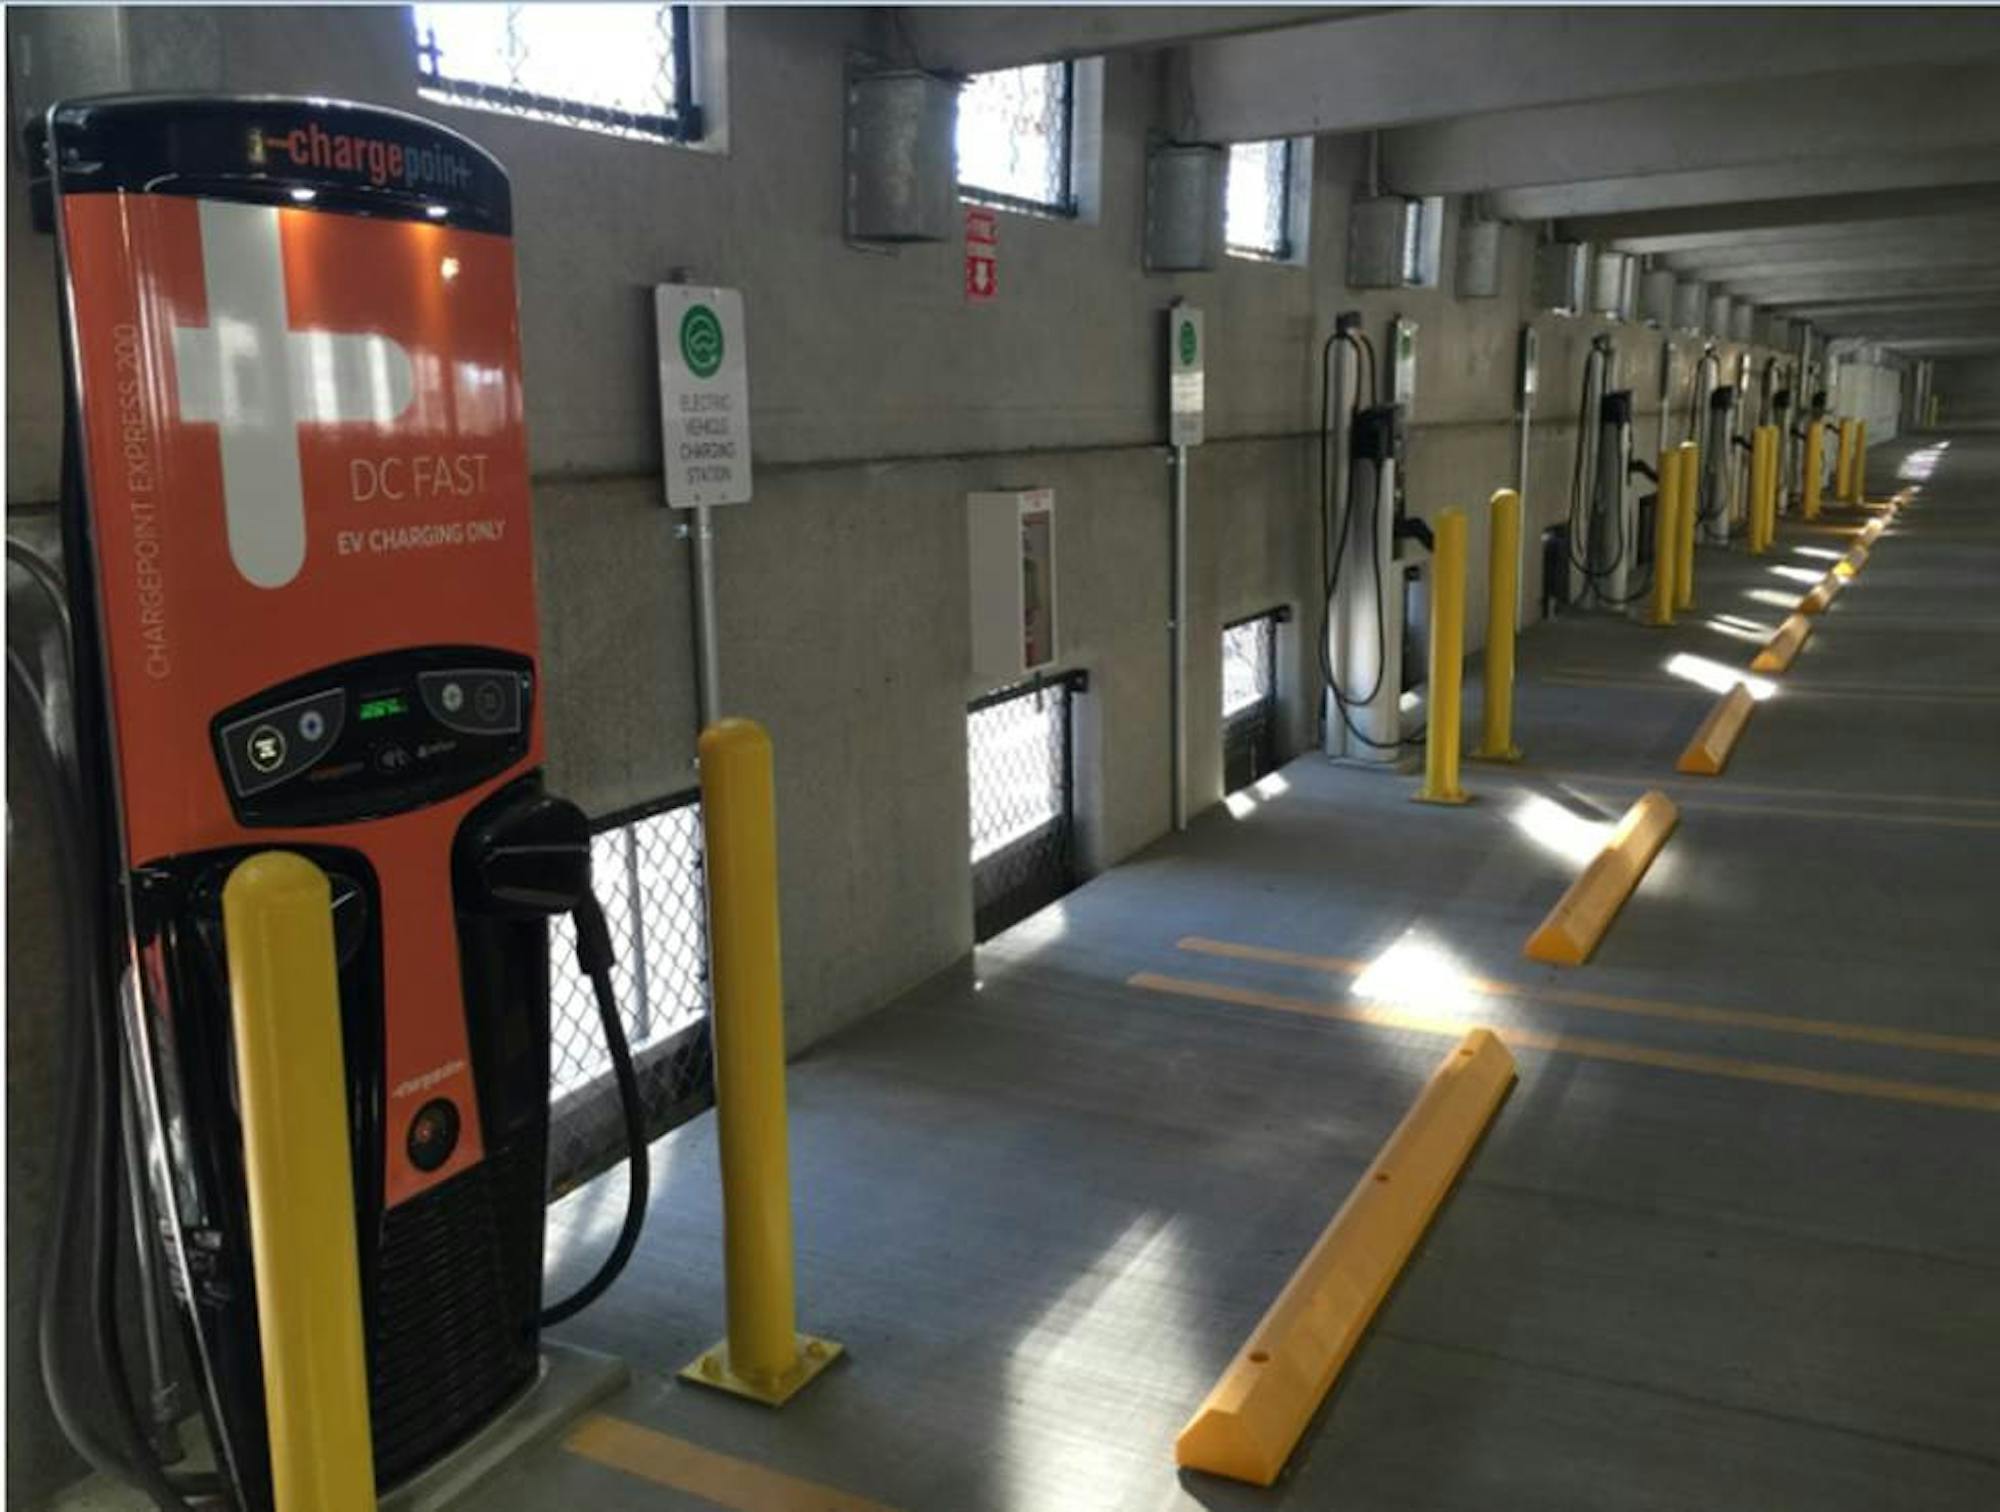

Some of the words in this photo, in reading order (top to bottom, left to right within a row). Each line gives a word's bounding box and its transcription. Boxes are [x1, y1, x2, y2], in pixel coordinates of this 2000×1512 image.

[117, 380, 154, 493] EXPRESS
[351, 457, 403, 501] DC
[412, 453, 489, 500] FAST
[337, 530, 364, 555] EV
[368, 524, 465, 554] CHARGING
[466, 519, 507, 543] ONLY
[130, 501, 171, 680] CHARGEPOINT
